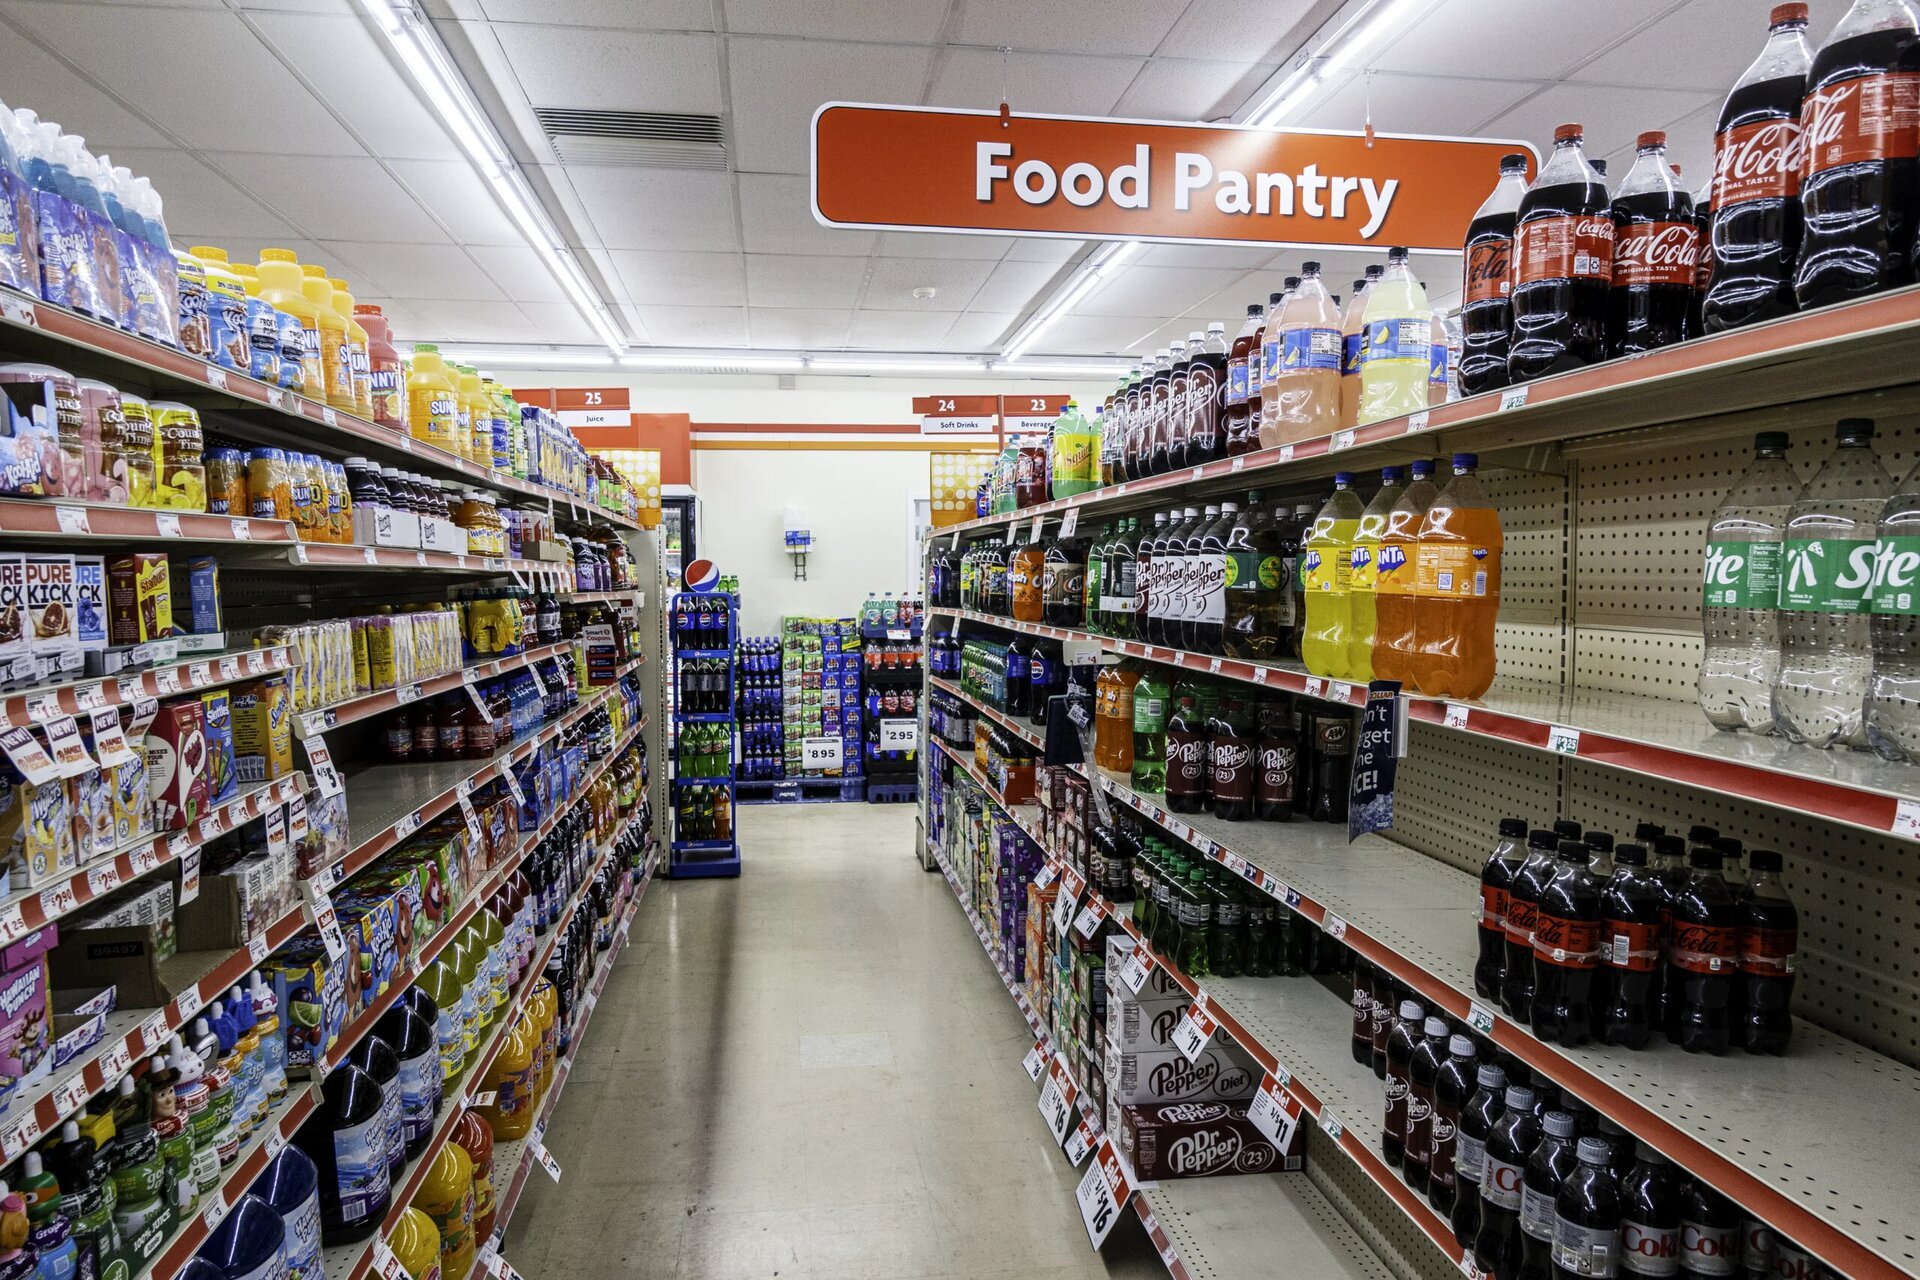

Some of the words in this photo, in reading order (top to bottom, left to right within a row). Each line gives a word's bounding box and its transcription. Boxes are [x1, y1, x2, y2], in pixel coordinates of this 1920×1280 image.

[975, 140, 1150, 208] Food
[1174, 151, 1399, 240] Pantry
[1617, 265, 1654, 275] ORIGINAL
[585, 392, 602, 405] 25
[938, 400, 956, 412] 24
[1030, 399, 1047, 411] 23
[586, 414, 605, 423] Juice
[26, 565, 73, 584] PURE
[28, 584, 72, 604] KICK
[136, 700, 157, 718] NEW!
[234, 701, 256, 709] Make
[49, 718, 76, 739] NEW!
[96, 709, 118, 731] NEW!
[1, 728, 31, 748] NEW!
[1216, 746, 1249, 766] Pepper
[1225, 744, 1239, 755] Dr
[1186, 766, 1197, 775] 23
[1218, 769, 1229, 779] 23
[1271, 773, 1282, 783] 23
[1193, 1009, 1207, 1030] Sale!
[1056, 1068, 1070, 1096] Sale!
[1157, 1062, 1215, 1097] Pepper
[1220, 1074, 1246, 1092] Diet
[1270, 1084, 1290, 1109] Sale!
[1164, 1105, 1223, 1123] Pepper
[1178, 1102, 1204, 1111] Dr
[1194, 1130, 1219, 1152] Dr
[1177, 1136, 1236, 1174] Pepper
[1246, 1151, 1263, 1165] 23
[1103, 1158, 1122, 1197] Sale!
[133, 1231, 152, 1252] 100%
[152, 1207, 171, 1231] JUICE
[383, 1256, 399, 1279] Sale!
